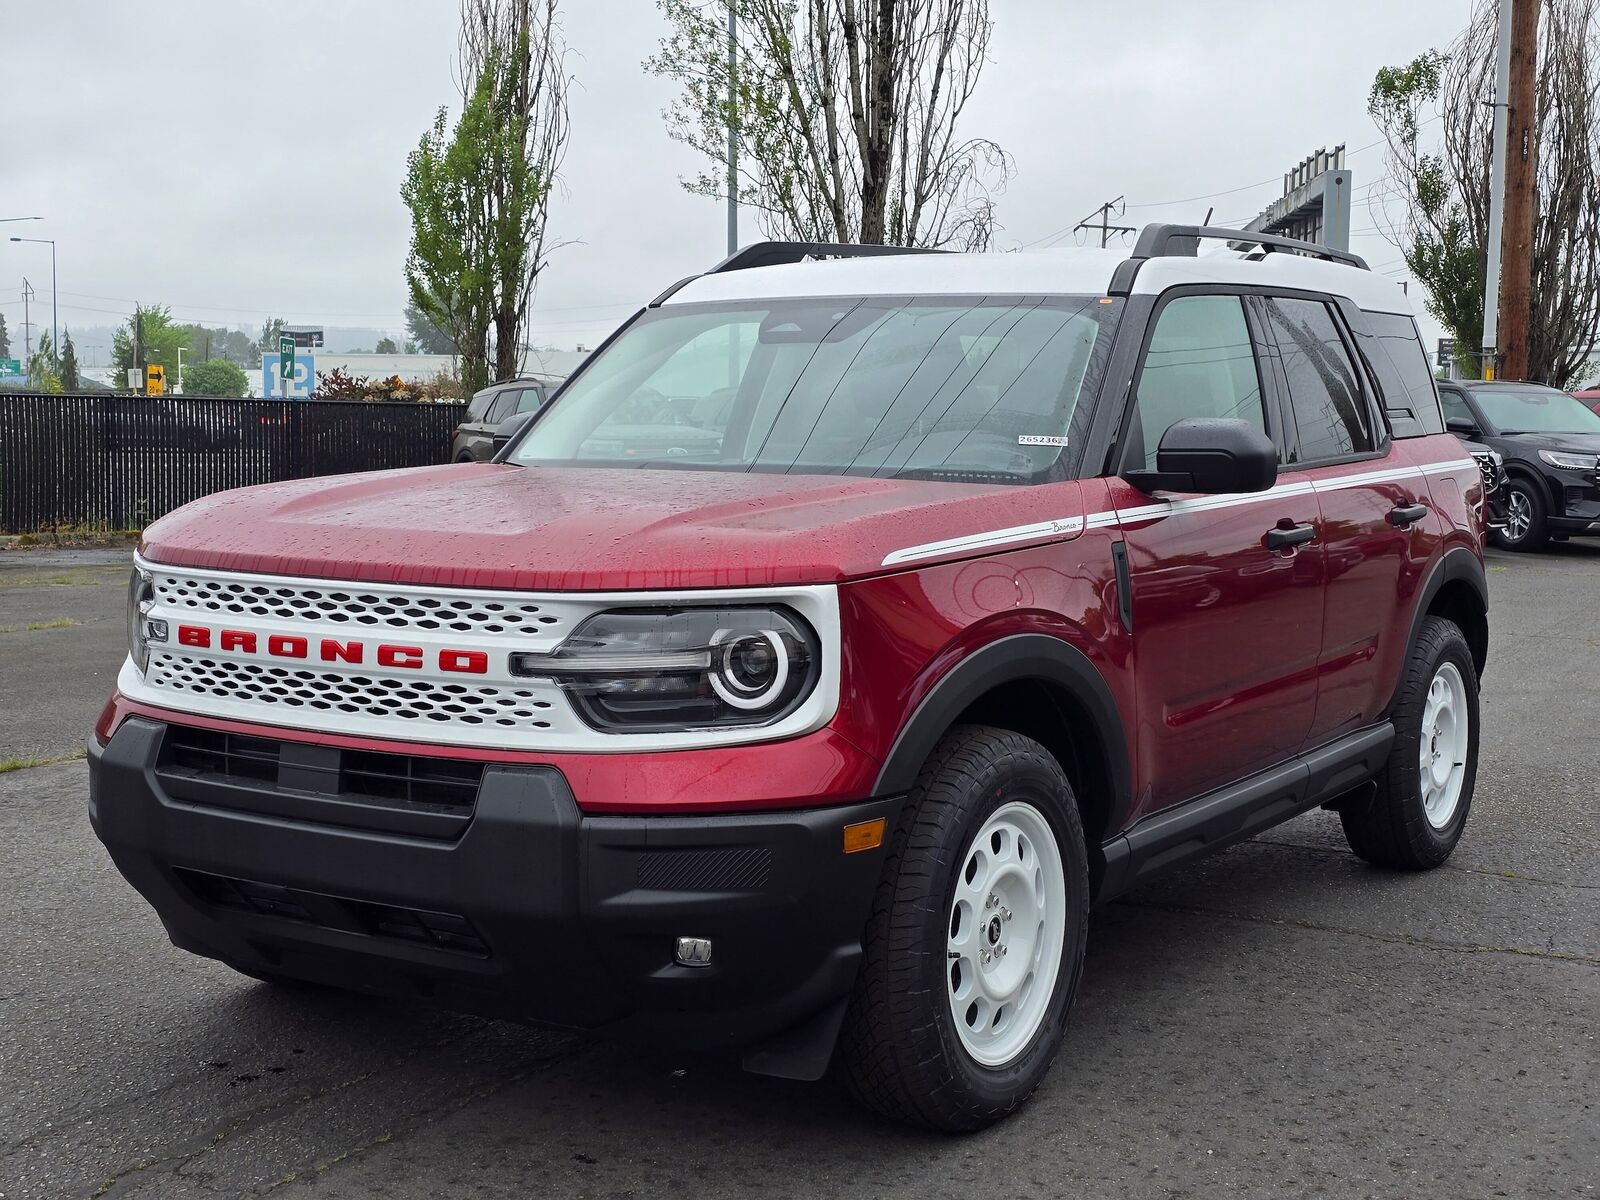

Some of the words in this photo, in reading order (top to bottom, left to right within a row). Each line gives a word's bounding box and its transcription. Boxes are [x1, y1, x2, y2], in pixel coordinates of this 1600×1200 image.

[282, 343, 293, 354] EXIT
[270, 362, 309, 397] 12
[1050, 521, 1077, 533] Bronco
[178, 624, 488, 674] BRONCO
